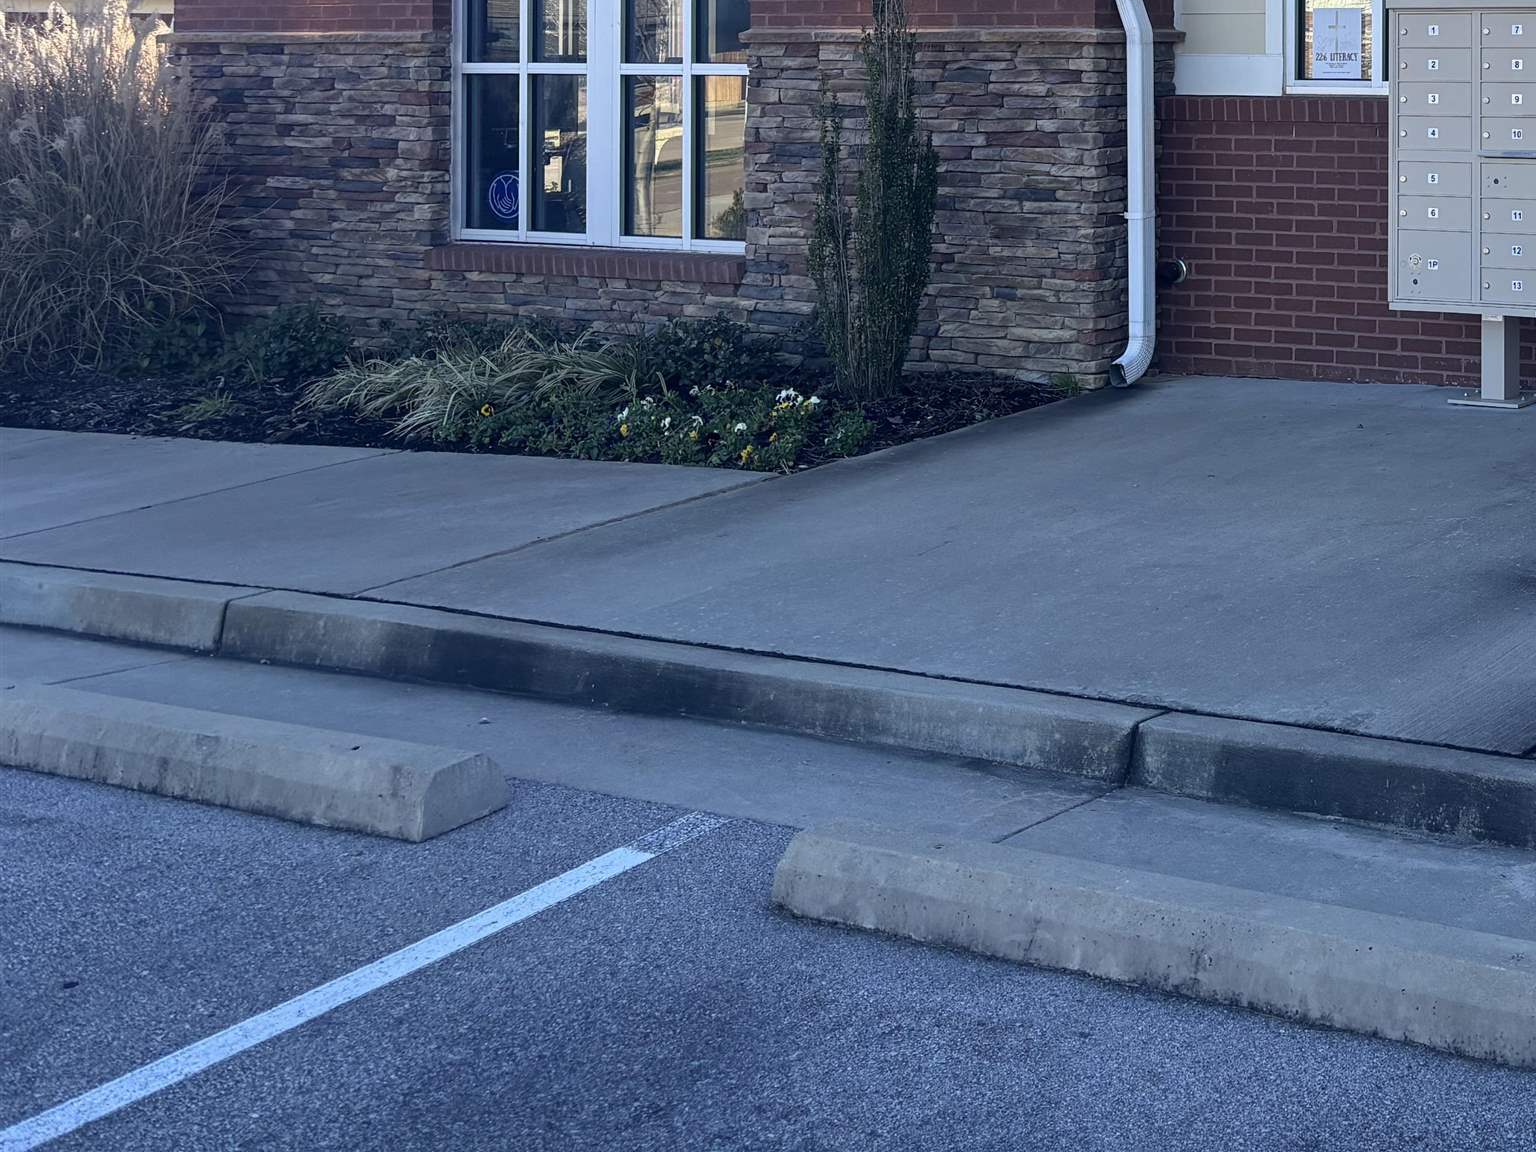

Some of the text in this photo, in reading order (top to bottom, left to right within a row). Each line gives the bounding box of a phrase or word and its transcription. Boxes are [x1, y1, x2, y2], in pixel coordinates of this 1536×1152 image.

[1330, 52, 1358, 62] LITERACY
[1514, 60, 1520, 69] 8
[1431, 95, 1436, 103] 3
[1514, 95, 1520, 104] 9
[1430, 129, 1436, 137] 4
[1513, 130, 1522, 139] 10
[1430, 208, 1436, 217] 6
[1513, 211, 1522, 220] 11
[1513, 246, 1522, 255] 12
[1429, 260, 1438, 268] 1P
[1513, 281, 1522, 290] 13
